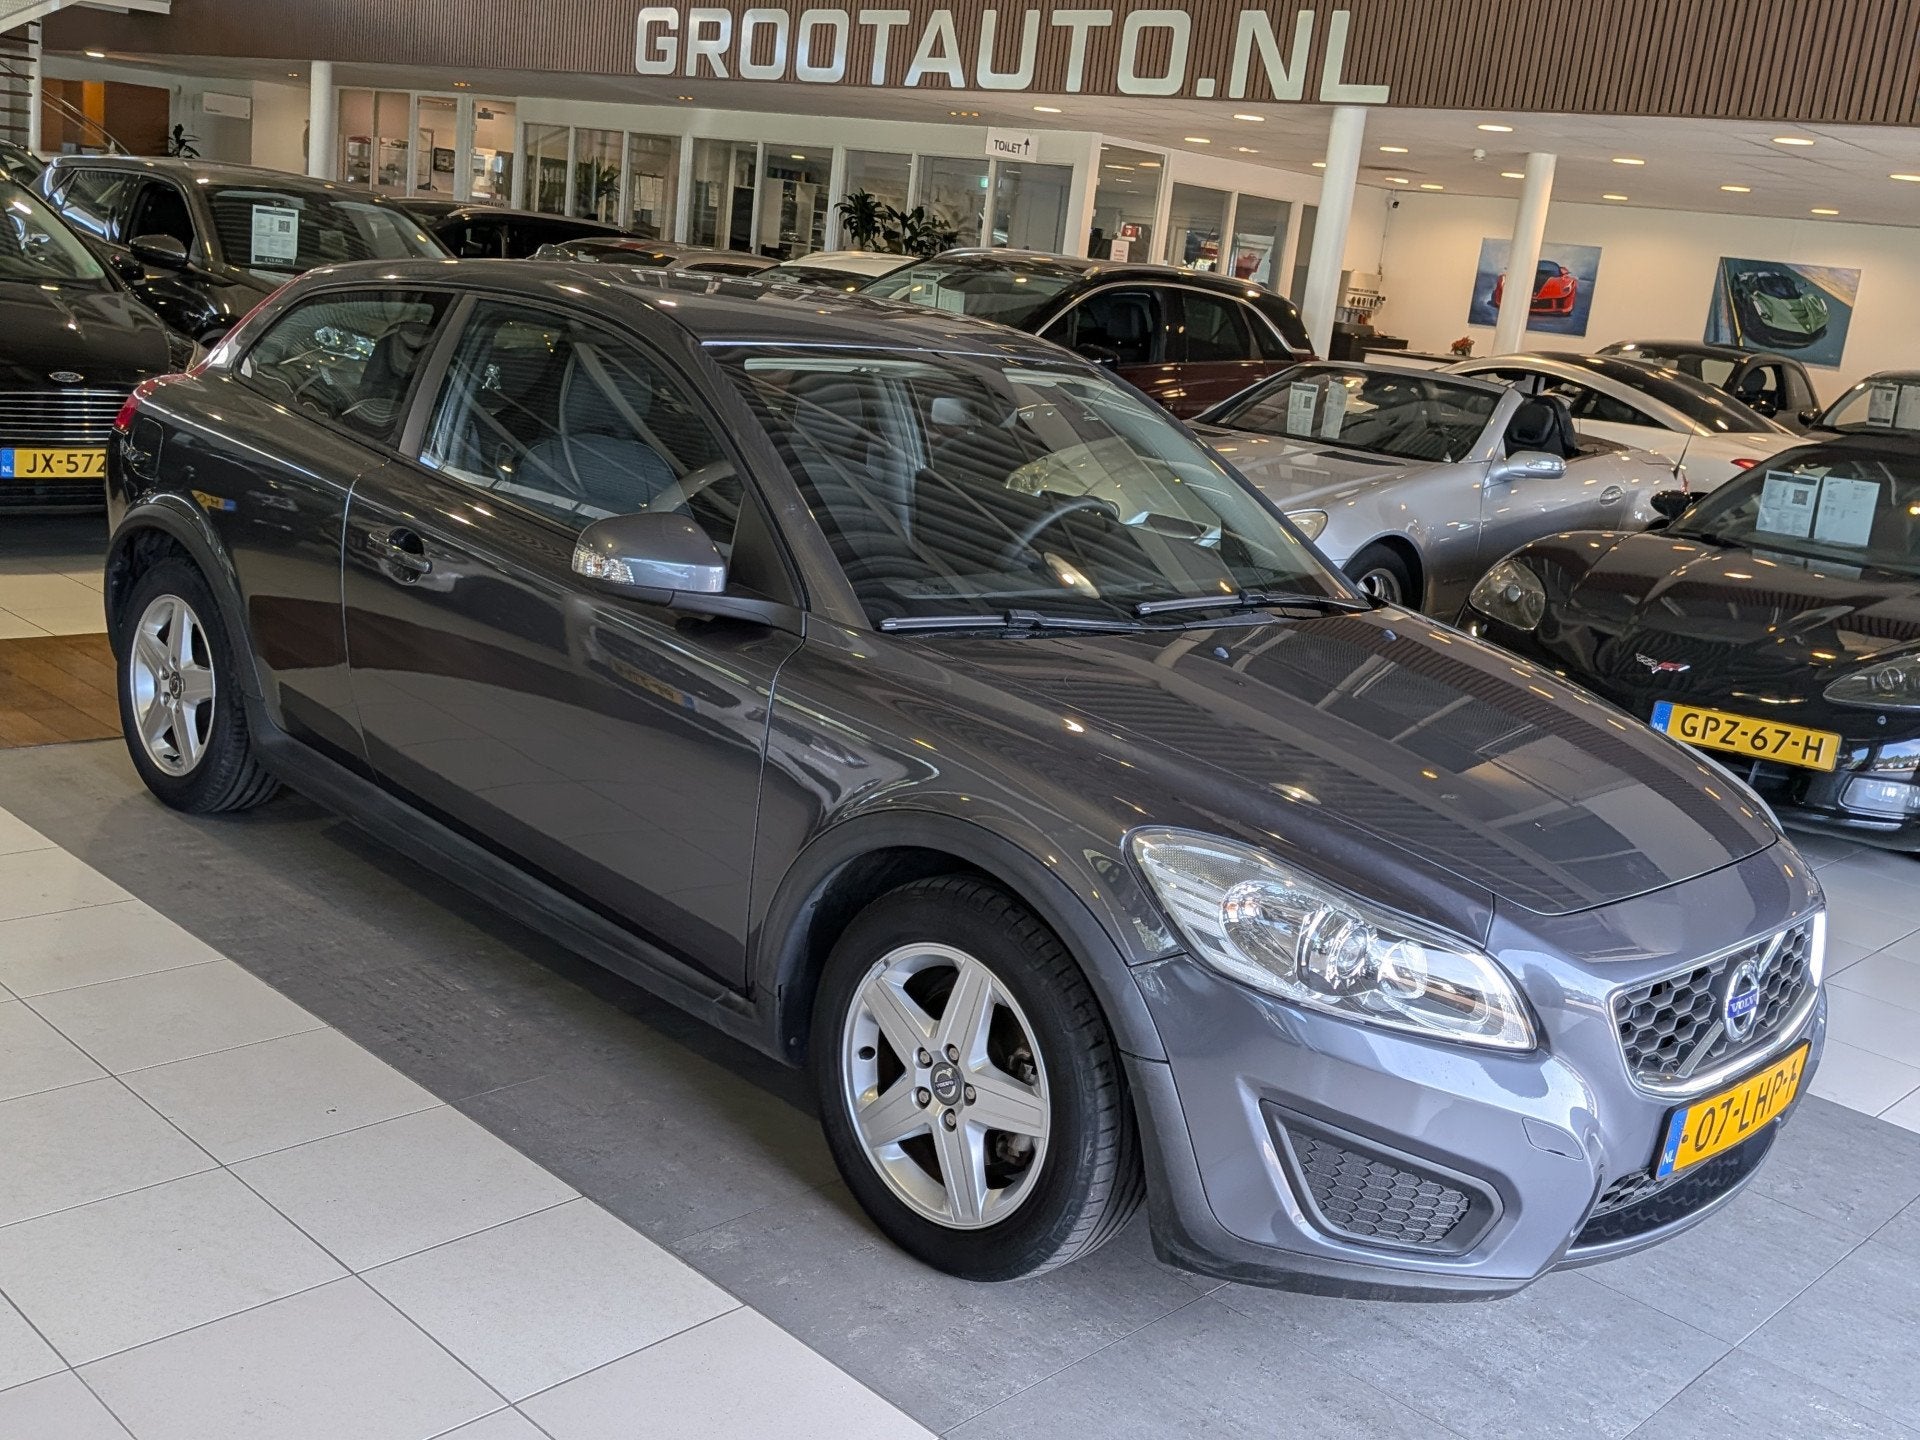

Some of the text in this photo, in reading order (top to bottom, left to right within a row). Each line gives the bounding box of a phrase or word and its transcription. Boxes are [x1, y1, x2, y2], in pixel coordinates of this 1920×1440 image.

[635, 7, 1390, 104] GROOTAUTO.NL
[994, 140, 1022, 154] TOILET
[1652, 713, 1825, 763] NL GPZ-67-H
[1662, 1150, 1674, 1165] NL
